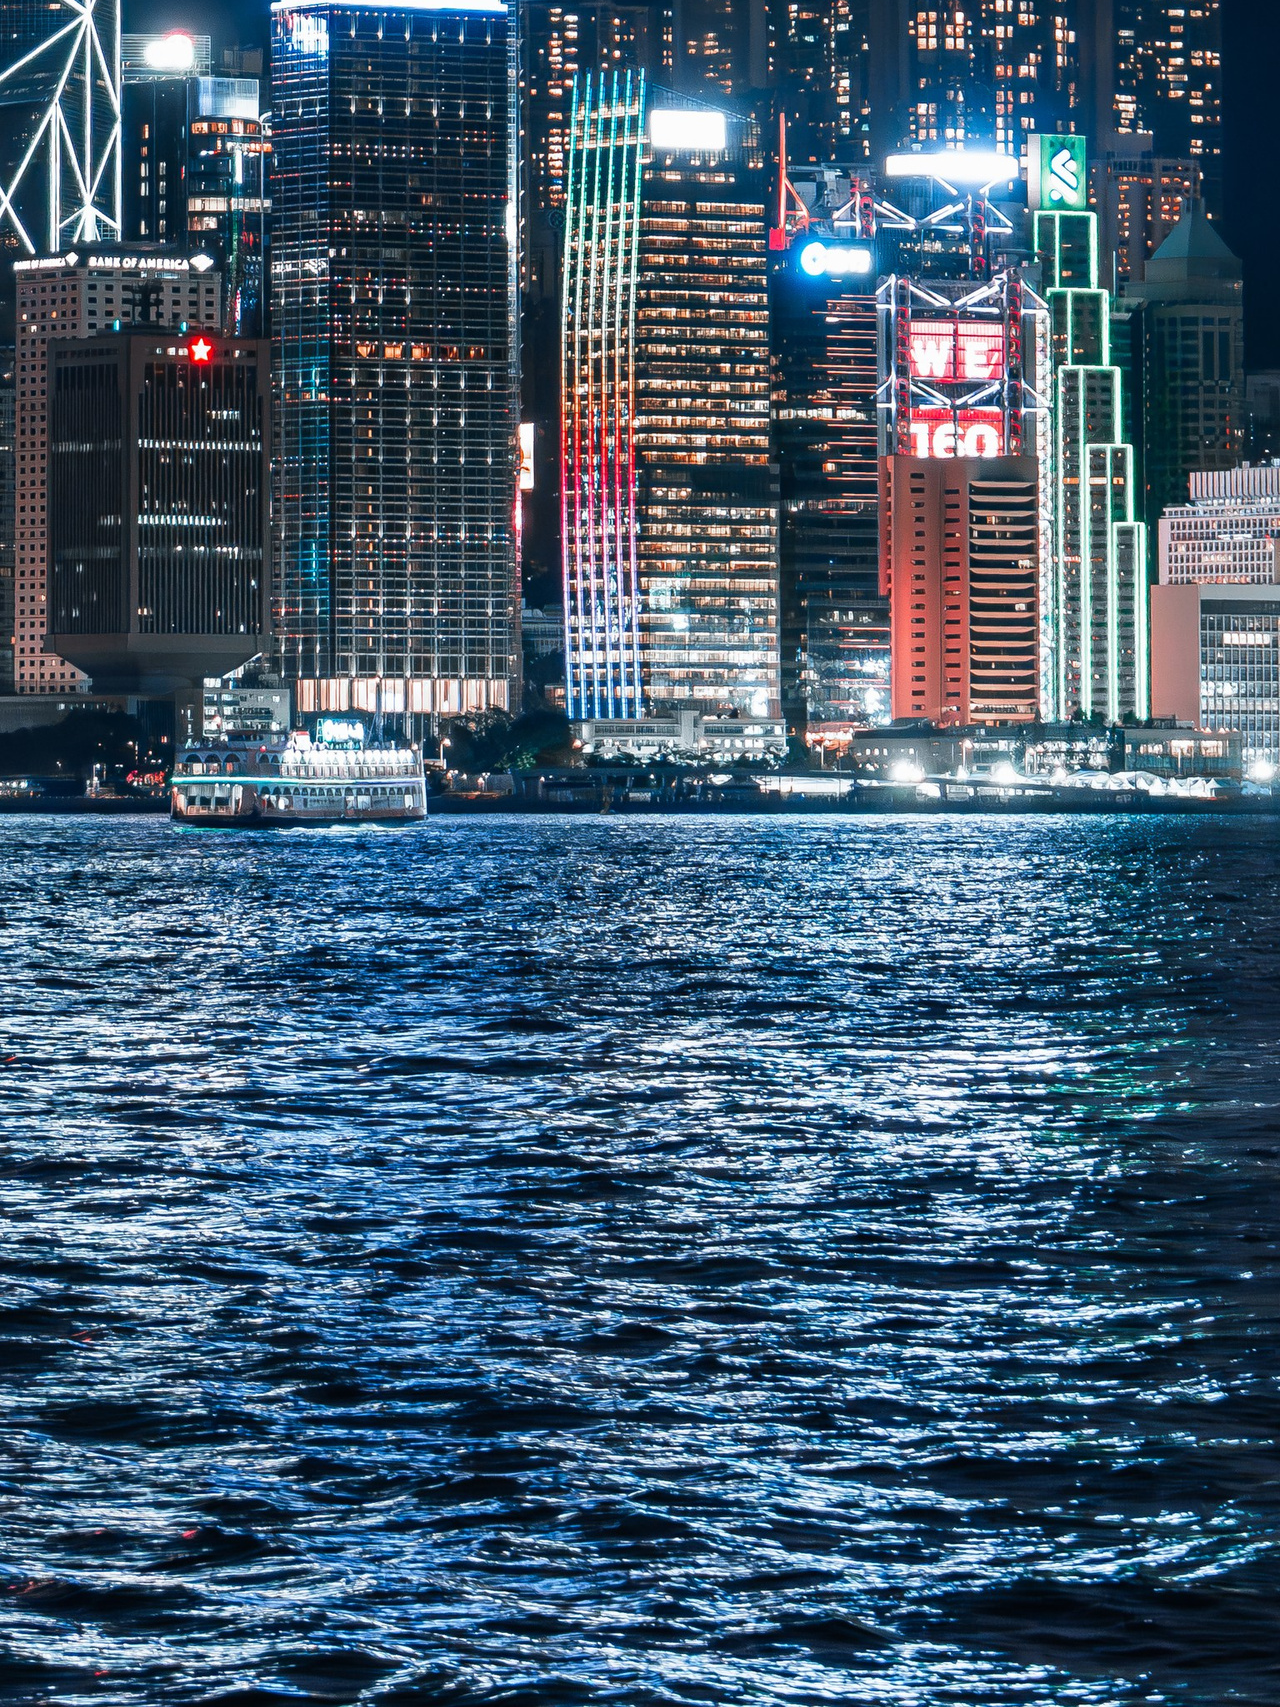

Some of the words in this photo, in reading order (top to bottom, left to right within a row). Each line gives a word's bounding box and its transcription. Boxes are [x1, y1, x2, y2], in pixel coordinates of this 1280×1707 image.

[89, 256, 121, 268] BANK
[122, 257, 137, 269] OF
[138, 257, 190, 270] AMERICA
